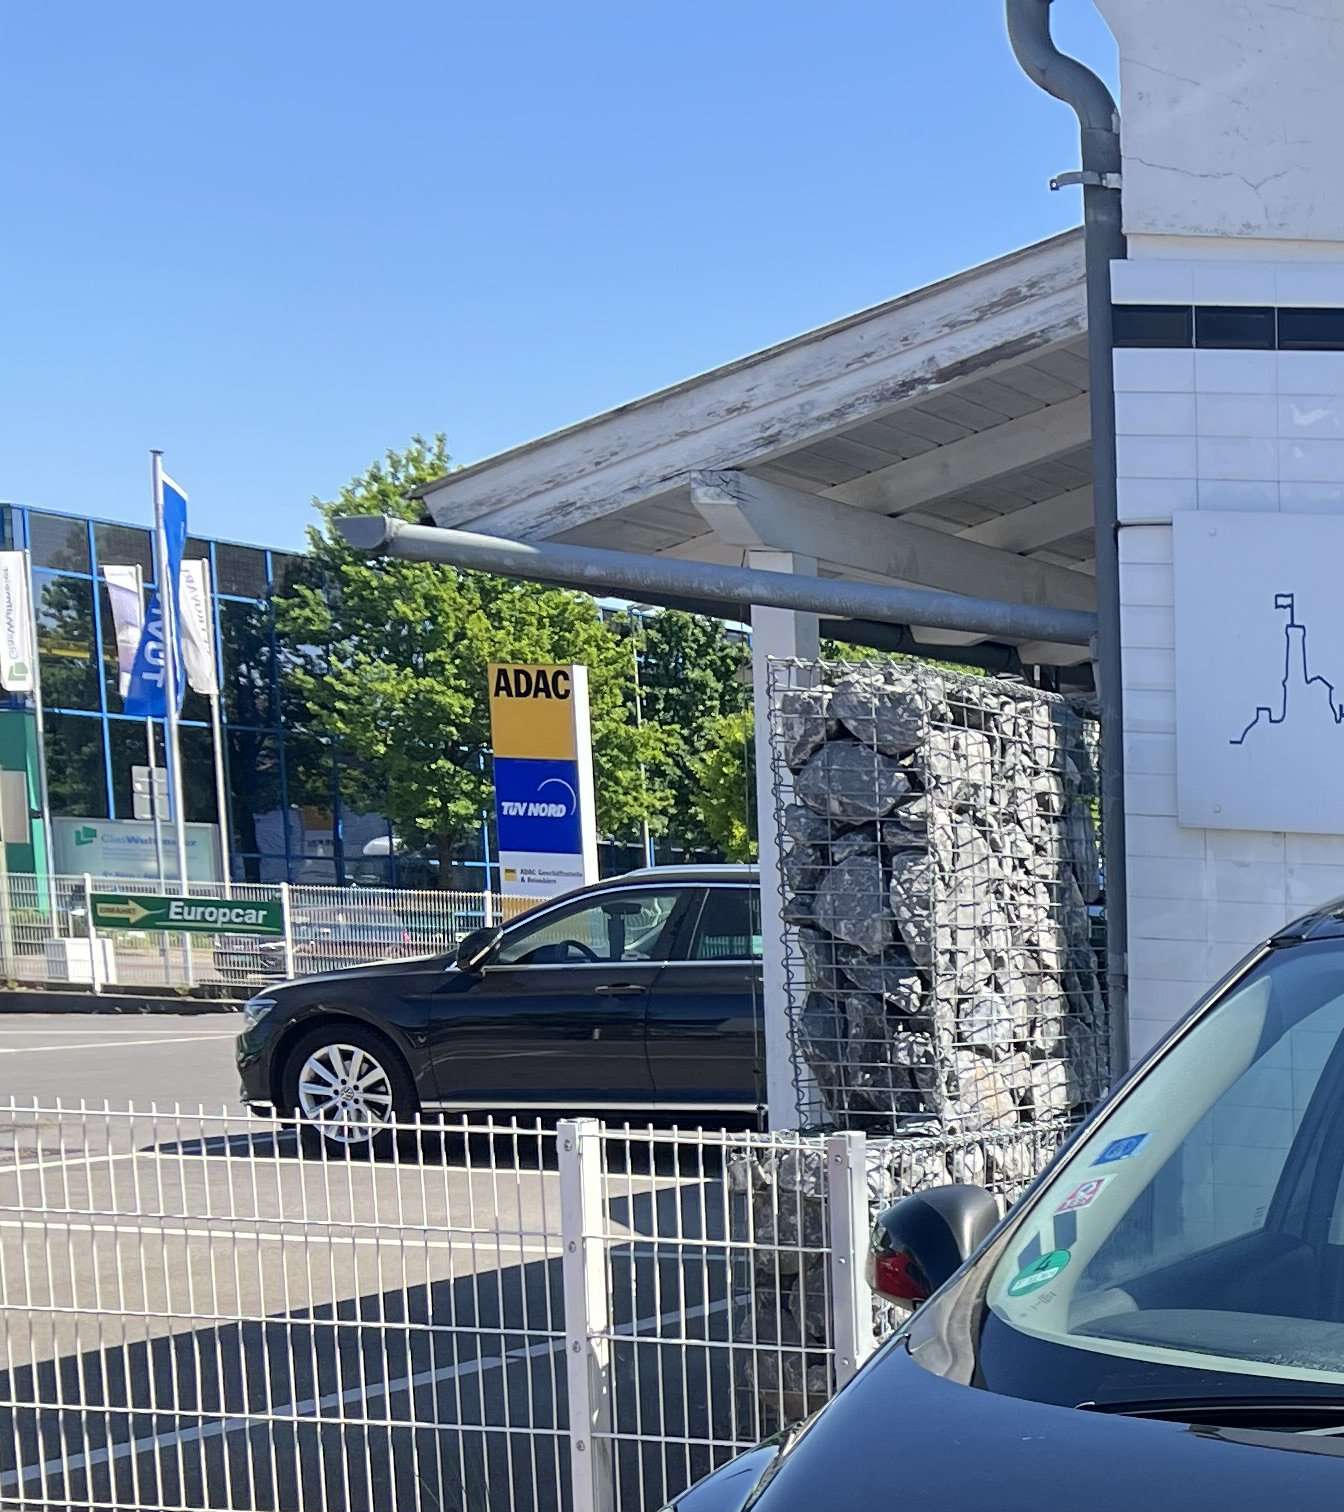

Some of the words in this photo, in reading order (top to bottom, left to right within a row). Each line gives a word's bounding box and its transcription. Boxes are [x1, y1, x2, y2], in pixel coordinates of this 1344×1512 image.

[493, 667, 571, 700] ADAC
[500, 800, 527, 817] TÜV
[527, 802, 568, 818] NORD
[168, 900, 268, 928] Europcar
